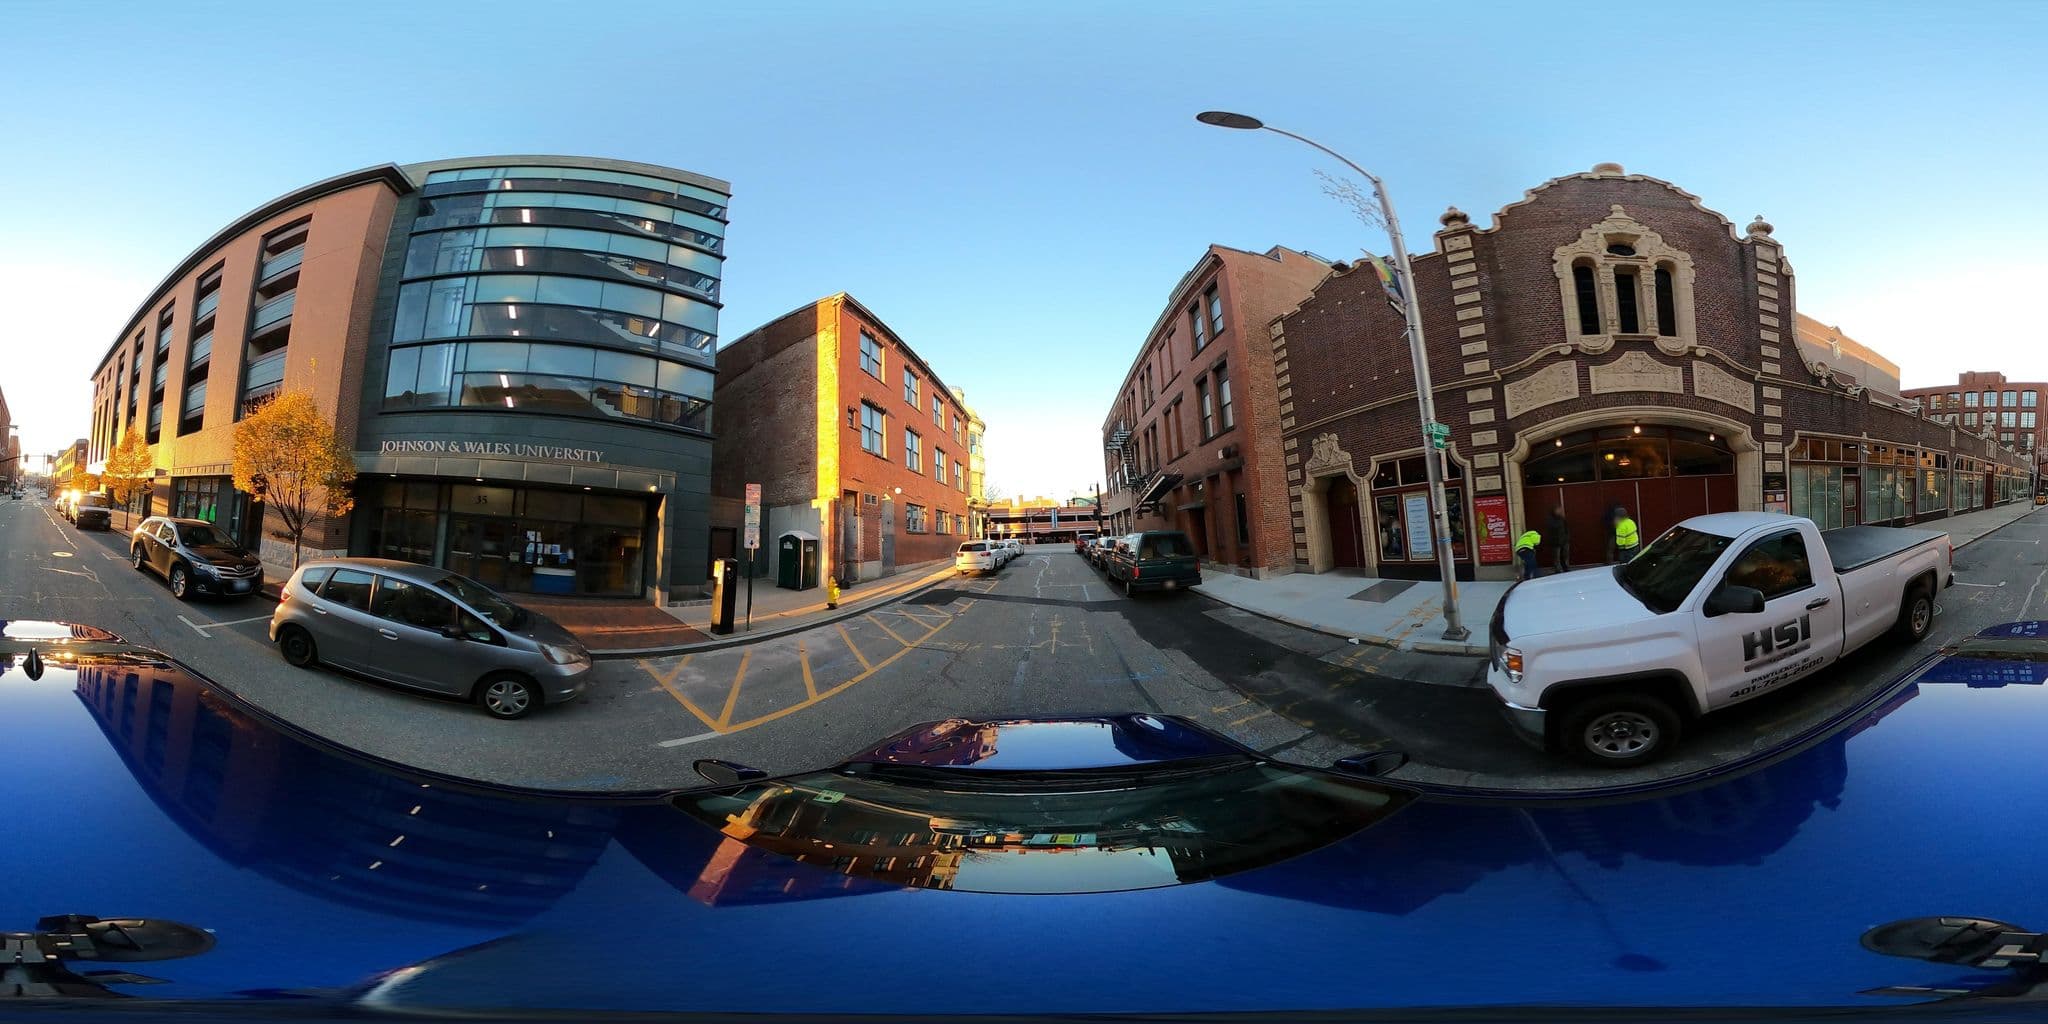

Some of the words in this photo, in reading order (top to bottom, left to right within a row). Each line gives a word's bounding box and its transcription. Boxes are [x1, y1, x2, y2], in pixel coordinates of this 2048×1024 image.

[380, 440, 446, 455] JOHNSON
[448, 441, 461, 453] &
[464, 441, 511, 455] WALES
[514, 444, 604, 462] UNIVERSITY
[475, 495, 488, 505] 35
[1742, 613, 1811, 662] HSI
